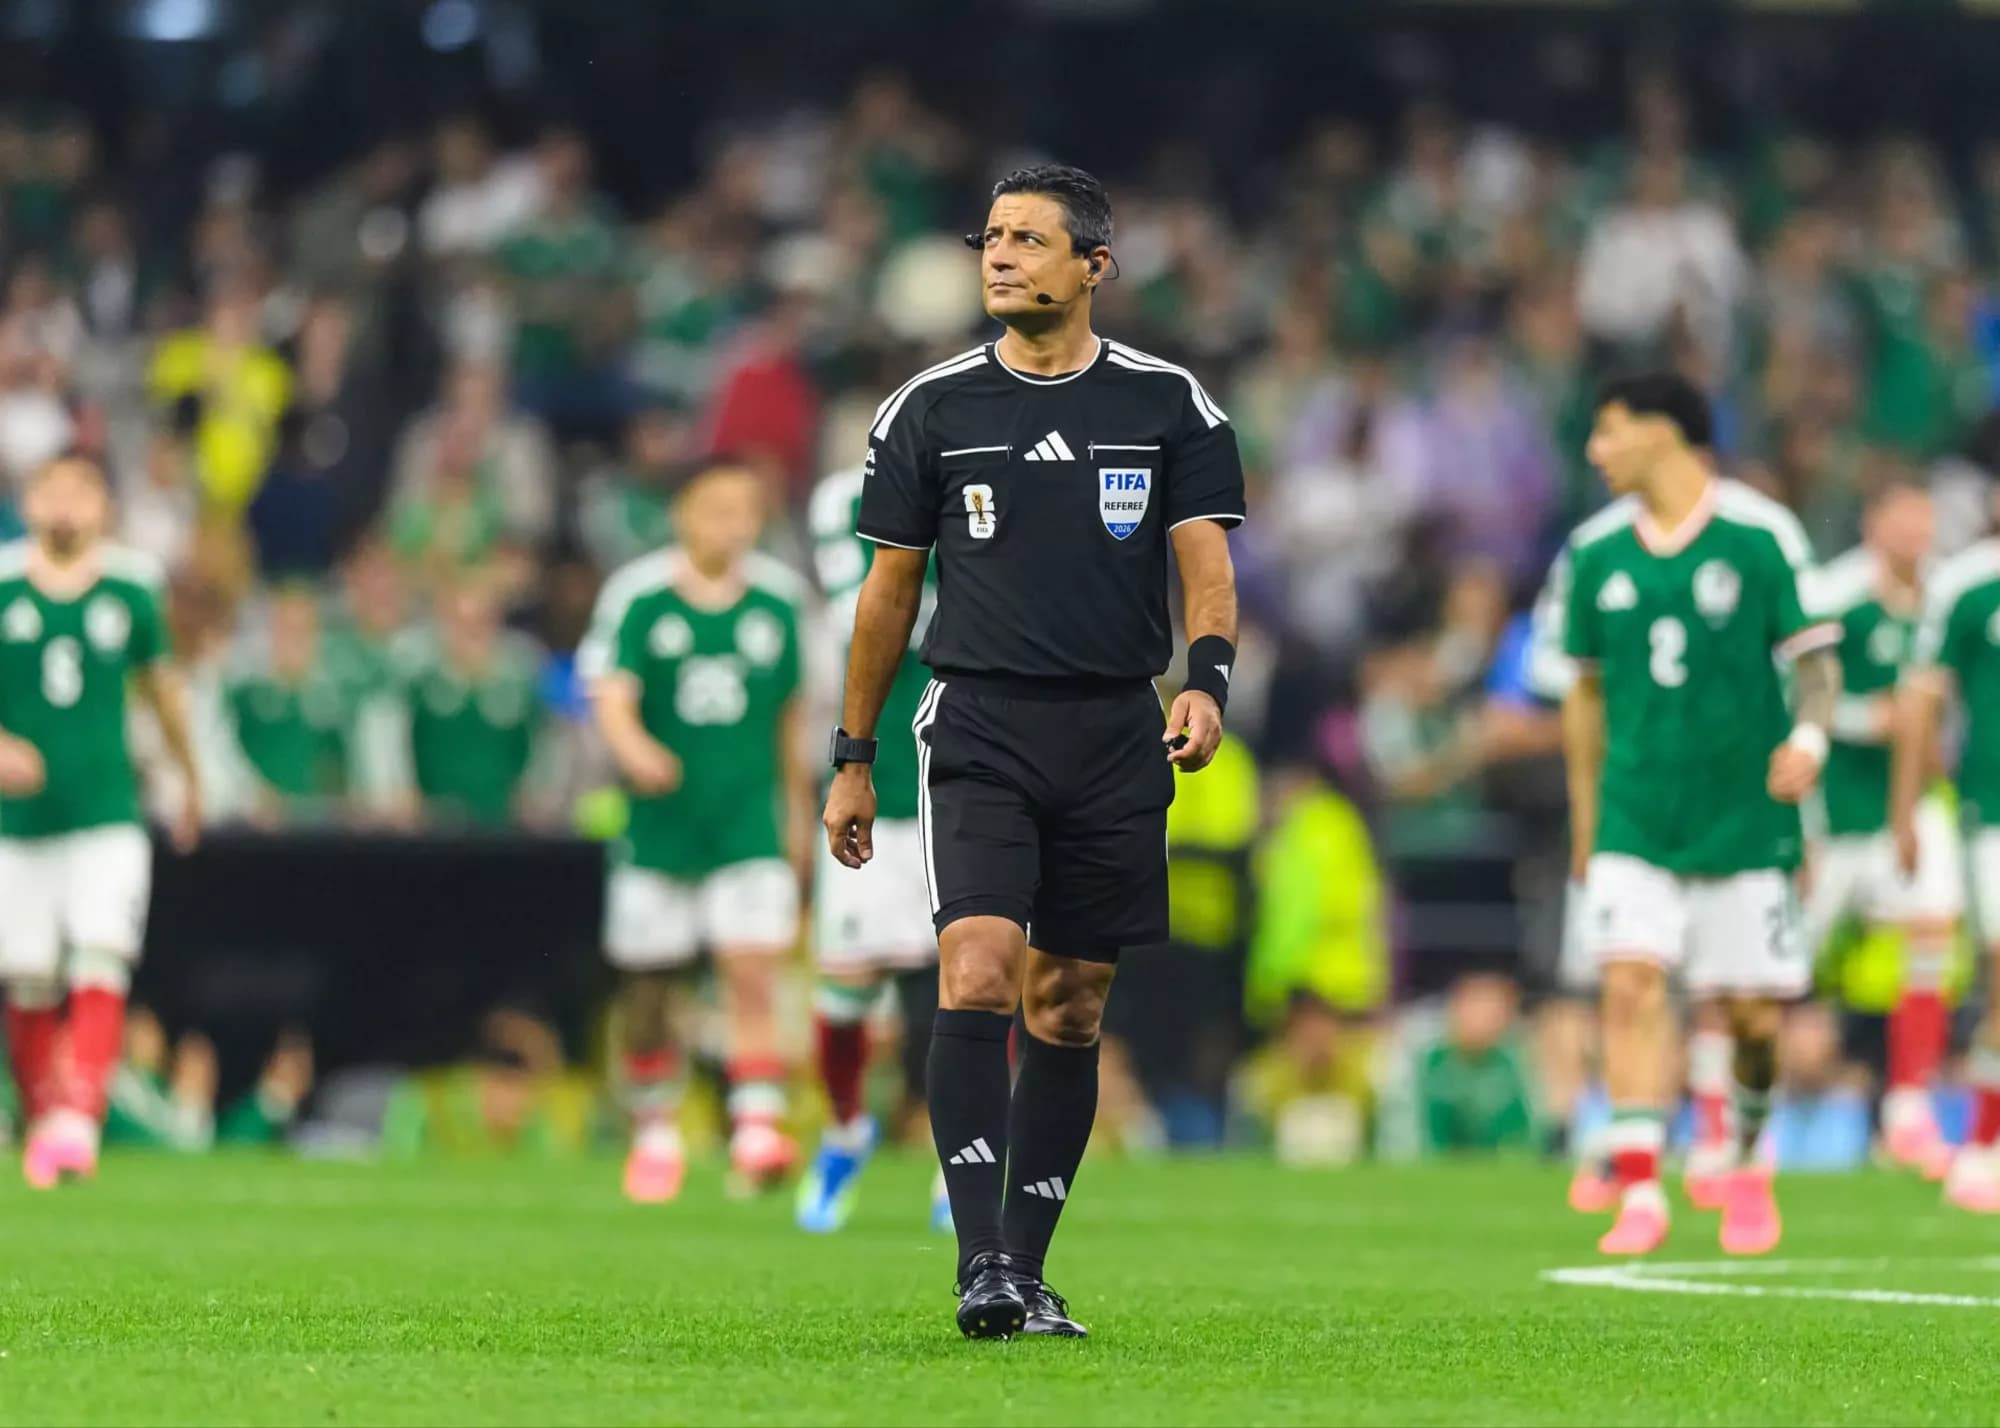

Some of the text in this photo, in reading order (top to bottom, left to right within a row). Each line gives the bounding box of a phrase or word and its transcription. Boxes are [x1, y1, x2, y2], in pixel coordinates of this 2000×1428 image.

[1105, 473, 1146, 490] FIFA
[1104, 501, 1144, 511] REFEREE
[1114, 525, 1131, 534] 2026
[1648, 615, 1688, 688] 2
